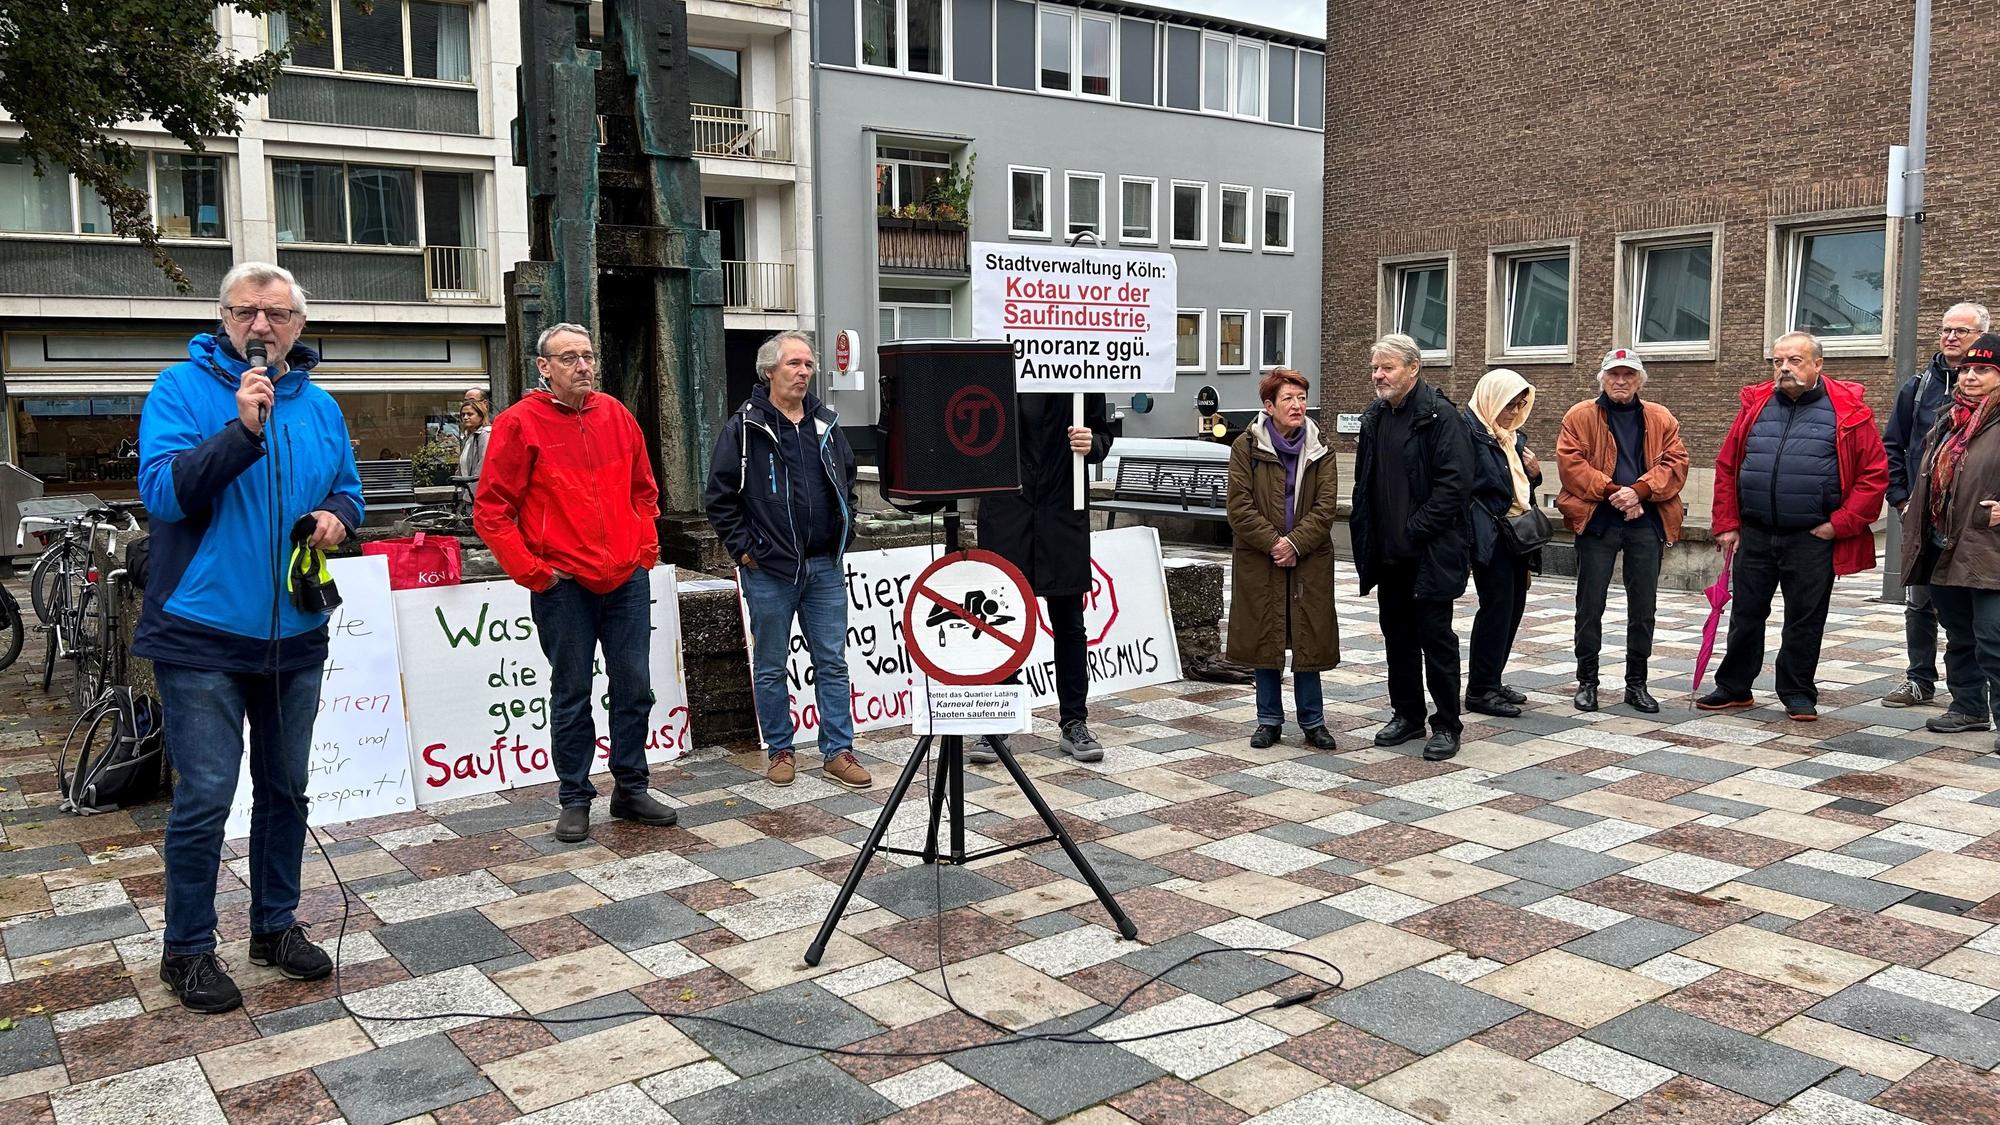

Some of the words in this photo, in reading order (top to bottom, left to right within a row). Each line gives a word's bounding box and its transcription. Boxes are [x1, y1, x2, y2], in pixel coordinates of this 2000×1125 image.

[985, 253, 1121, 280] Stadtverwaltung
[1126, 260, 1166, 279] Köln:
[1005, 276, 1070, 300] Kotau
[1077, 284, 1112, 302] vor
[1117, 282, 1151, 303] der
[1004, 303, 1151, 331] Saufindustrie,
[1106, 336, 1150, 361] ggü.
[1020, 359, 1141, 380] Anwohnern
[434, 602, 534, 648] Was
[487, 657, 537, 689] die
[866, 655, 913, 676] voll
[928, 691, 948, 699] Rettet
[949, 691, 962, 699] das
[963, 690, 993, 699] Quartier
[936, 700, 974, 708] Karneval
[975, 699, 1000, 708] feiern
[1000, 699, 1010, 709] ja
[488, 696, 551, 736] geg
[930, 710, 965, 719] Chaoten
[967, 710, 996, 718] saufen
[997, 710, 1016, 718] nein
